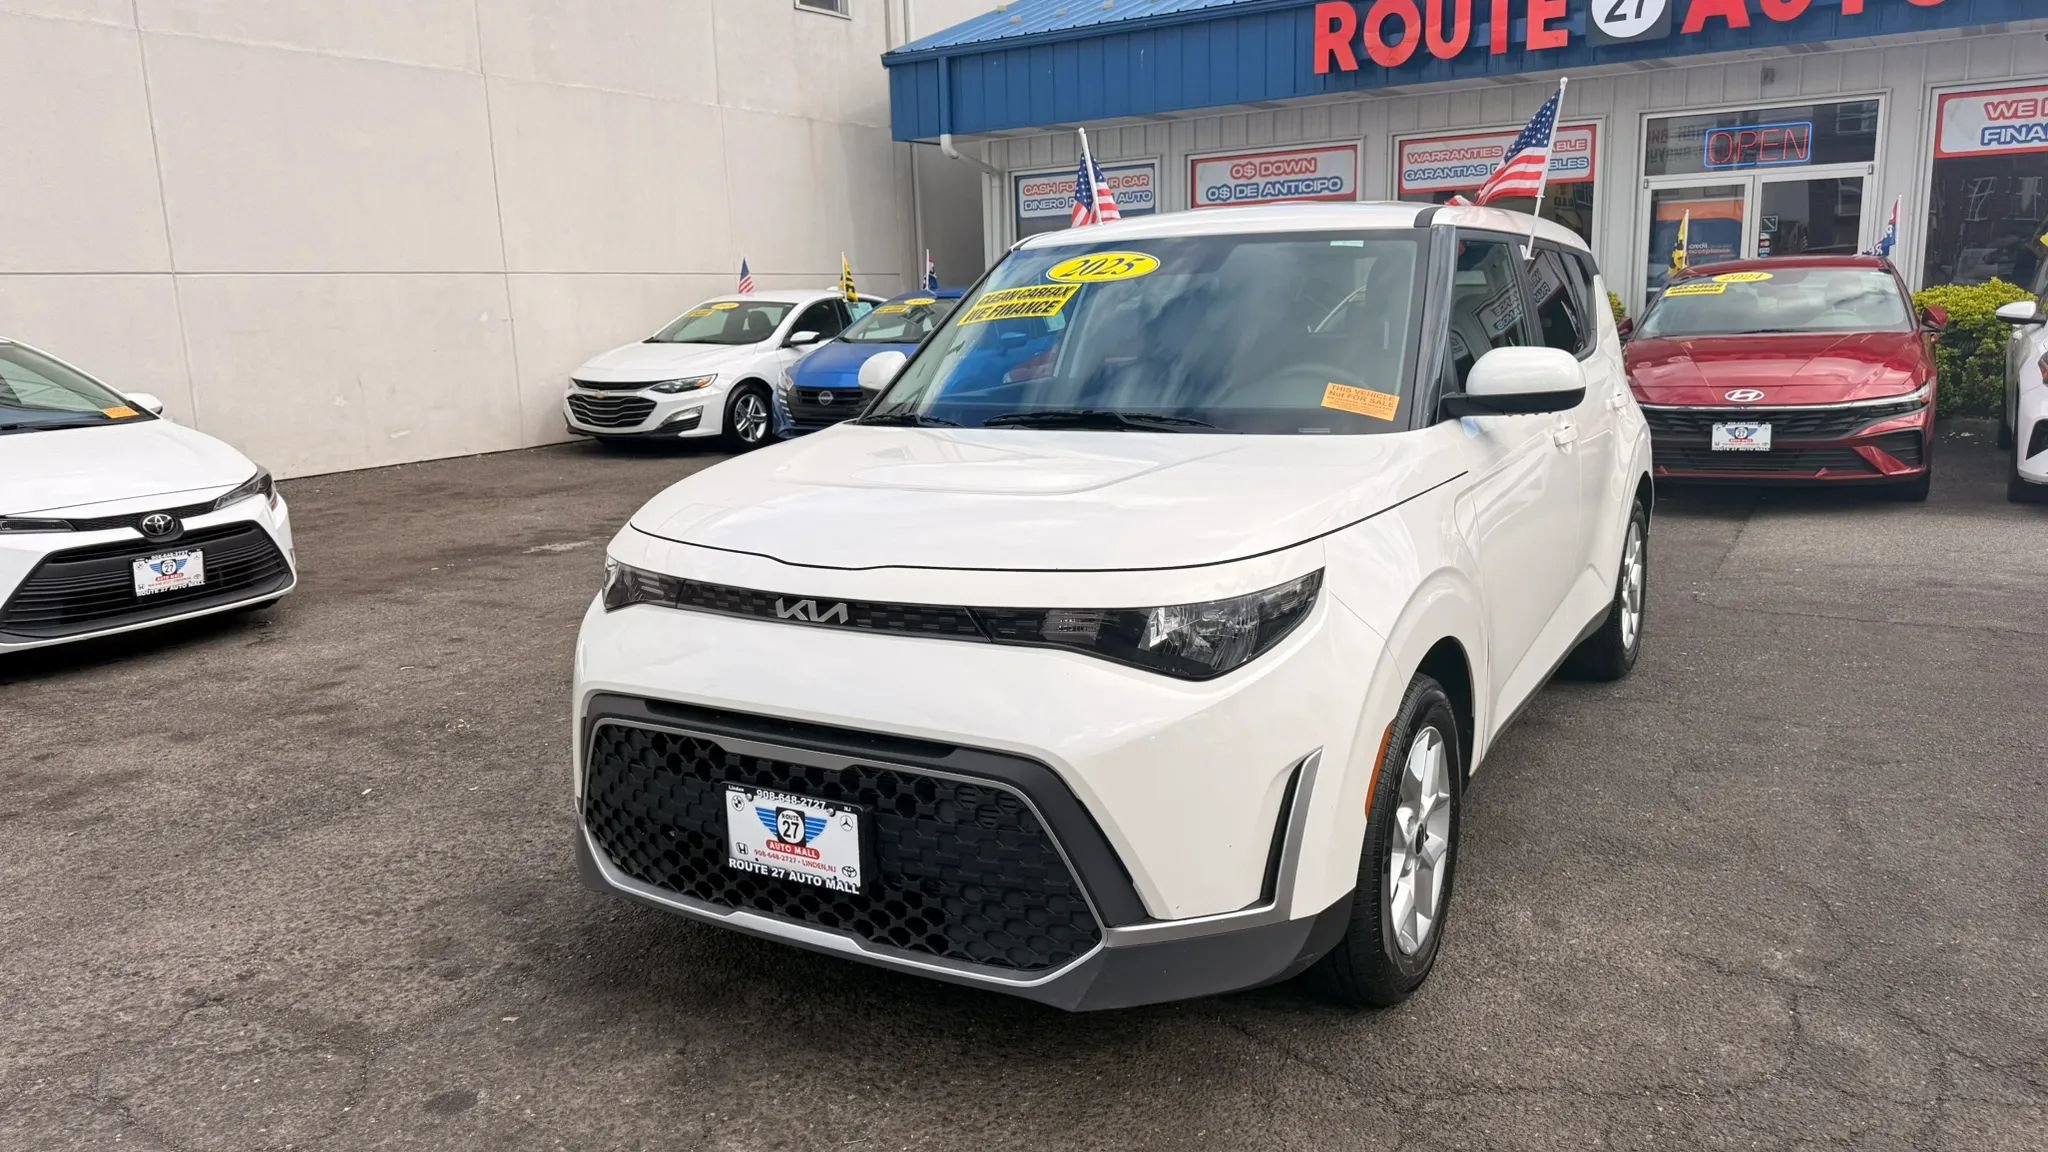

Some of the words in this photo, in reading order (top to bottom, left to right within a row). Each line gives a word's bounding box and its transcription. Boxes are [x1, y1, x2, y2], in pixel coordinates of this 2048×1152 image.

[1314, 0, 1568, 75] ROUTE
[1984, 99, 2038, 121] WE
[1708, 127, 1809, 164] OPEN
[1259, 157, 1317, 177] DOWN
[1403, 165, 1487, 182] GARANTIAS
[1023, 183, 1057, 196] CASH
[1121, 175, 1150, 188] CAR
[1234, 182, 1259, 199] DE
[1262, 176, 1343, 198] ANTICIPO
[1023, 197, 1066, 212] DINERO
[1116, 190, 1153, 203] AUTO
[1058, 257, 1146, 278] 2025
[1017, 285, 1077, 300] CARFAX
[986, 300, 1062, 319] FINANCE
[775, 597, 849, 624] KIA
[756, 789, 827, 810] 908-648-2727
[781, 813, 800, 822] ROUTE
[782, 820, 800, 839] 27
[769, 841, 793, 853] AUTO
[795, 846, 818, 859] MALL
[728, 857, 769, 876] ROUTE
[771, 866, 785, 879] 27
[788, 871, 822, 886] AUTO
[825, 878, 861, 895] MALL
